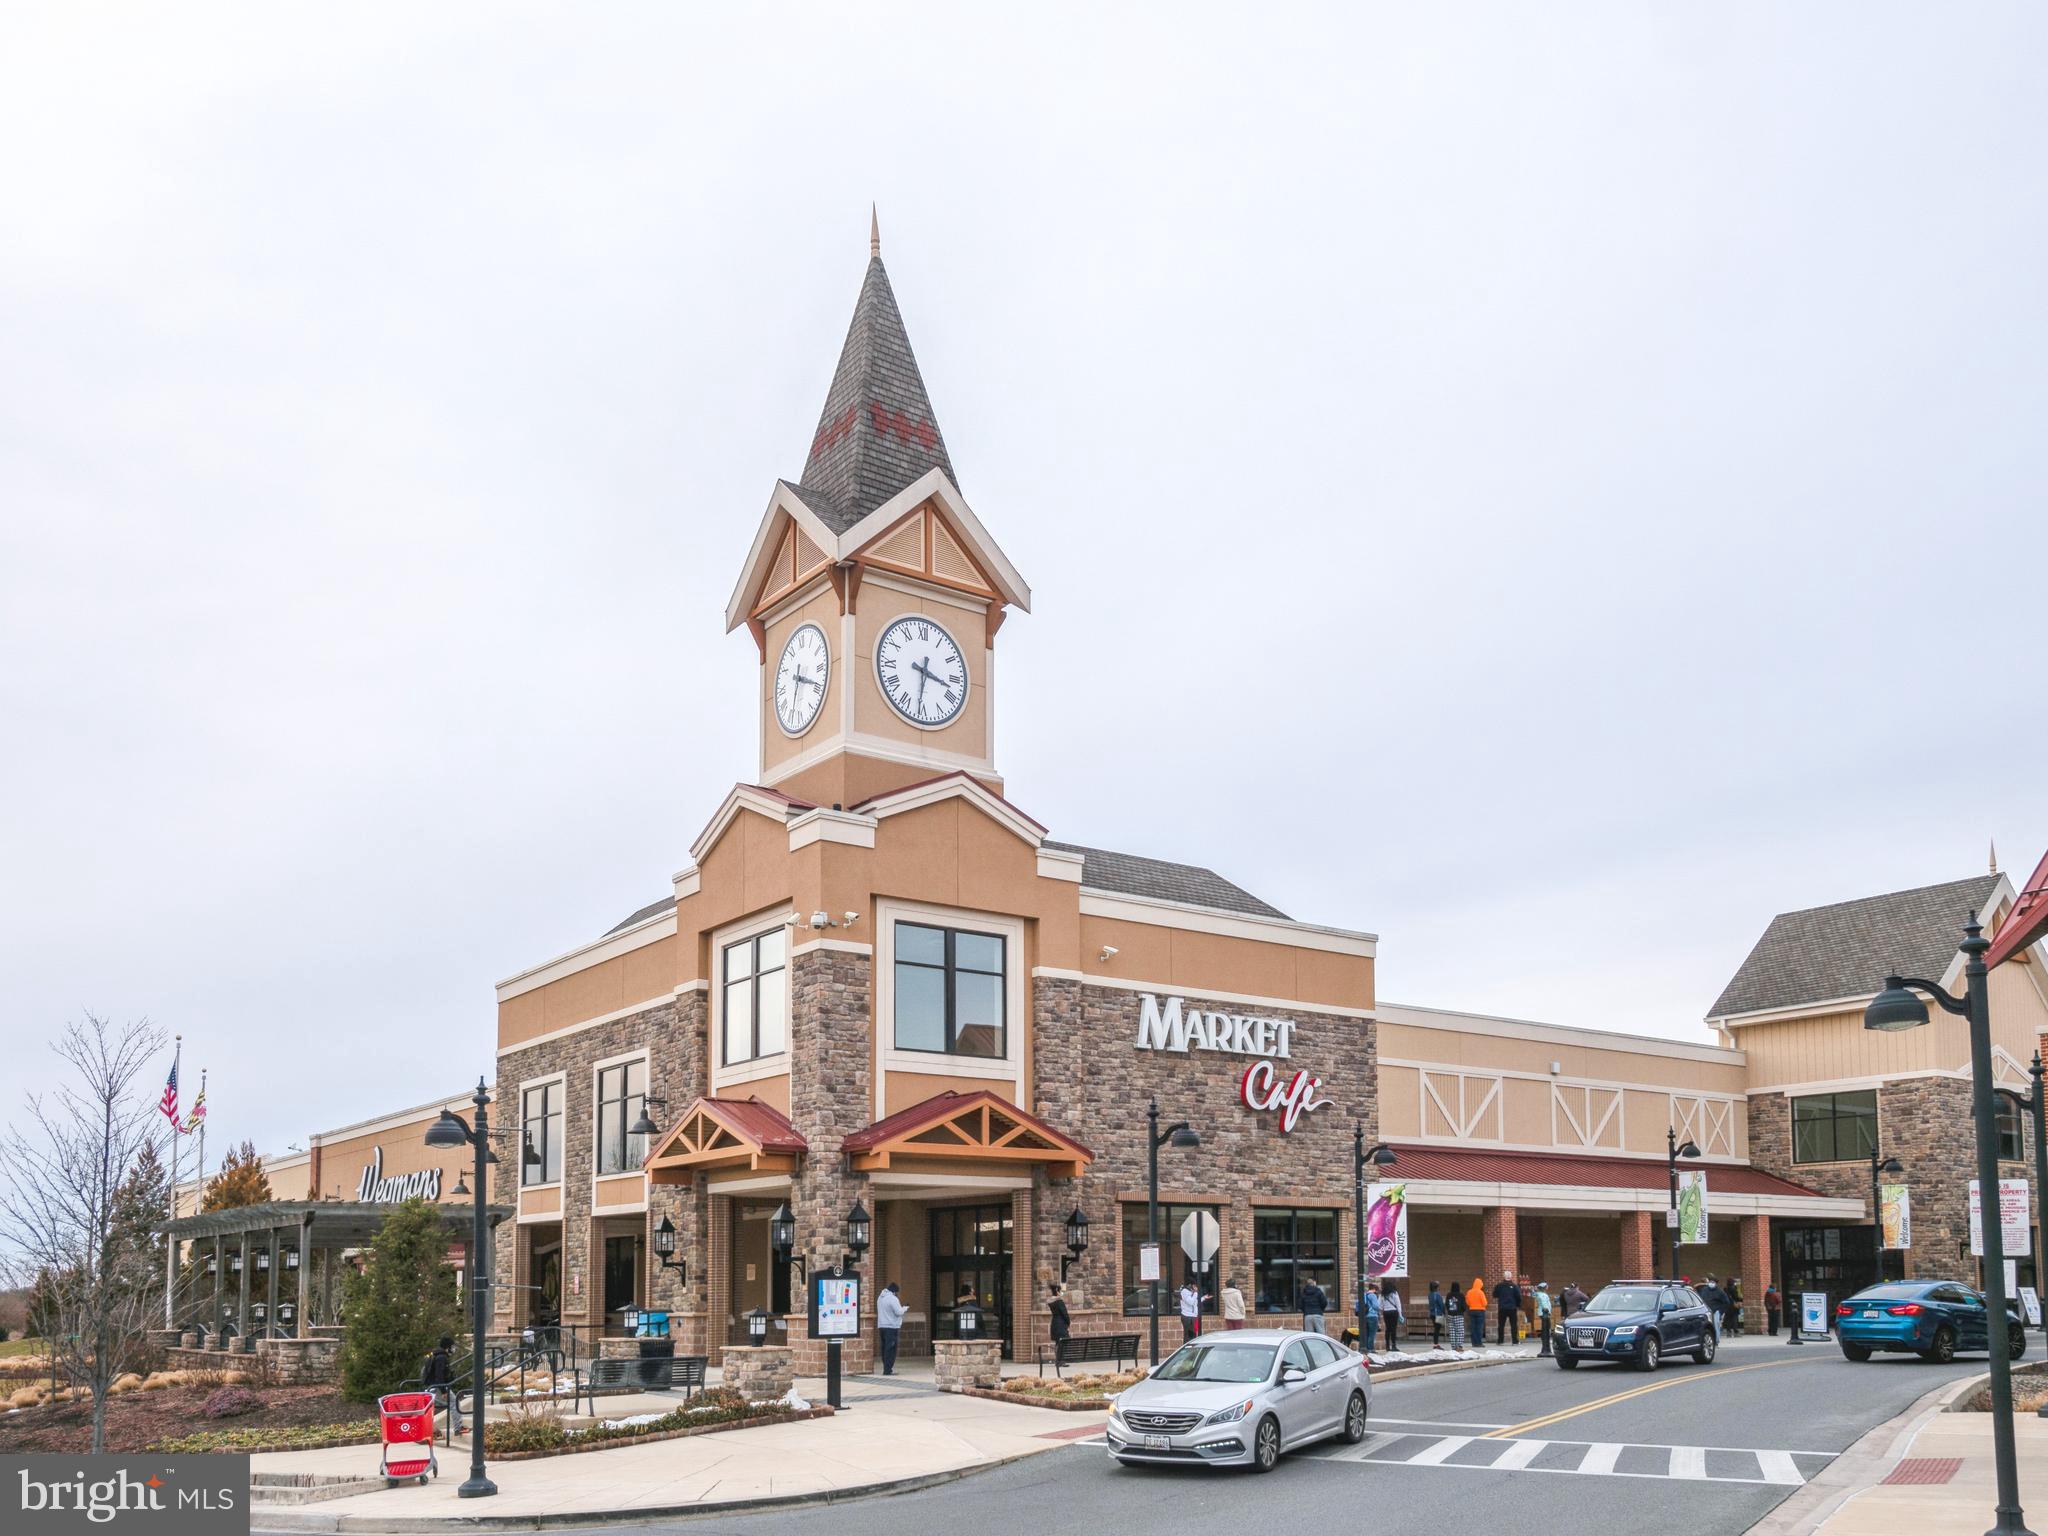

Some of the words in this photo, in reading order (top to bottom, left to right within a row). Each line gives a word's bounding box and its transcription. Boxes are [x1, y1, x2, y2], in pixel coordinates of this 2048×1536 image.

[900, 627, 913, 642] XI
[918, 626, 929, 641] XII
[889, 639, 901, 652] X
[884, 659, 897, 669] IX
[945, 655, 956, 664] II
[886, 674, 901, 692] VIII
[949, 674, 961, 684] III
[899, 691, 911, 709] VII
[936, 702, 944, 714] V
[1241, 1060, 1335, 1133] Café
[355, 1145, 443, 1204] Wegmans
[1369, 1241, 1394, 1258] Veggies
[1392, 1230, 1405, 1270] Welcome
